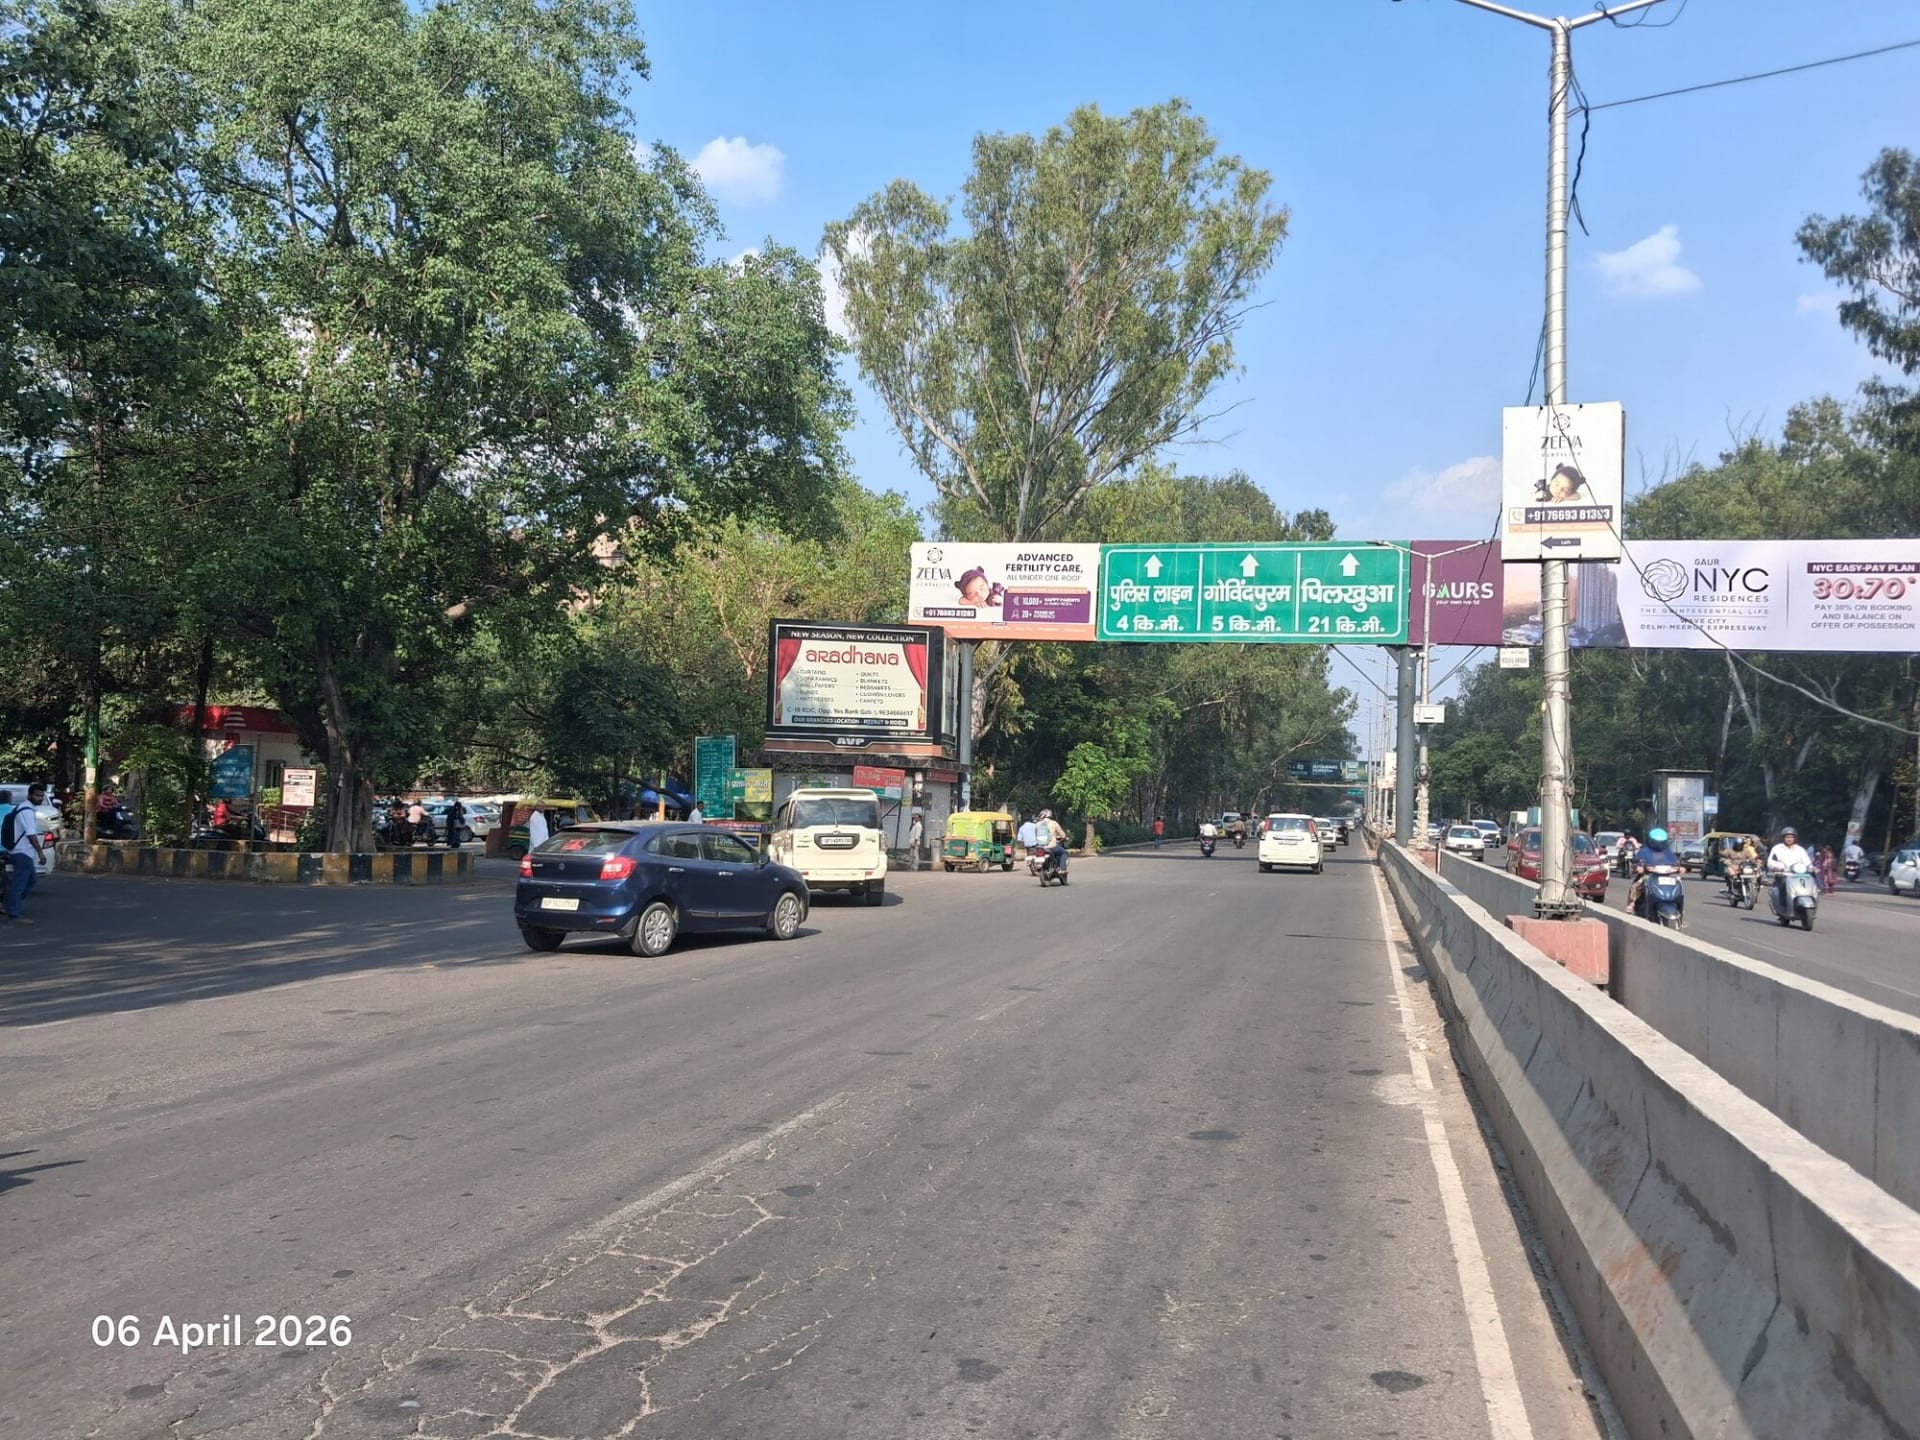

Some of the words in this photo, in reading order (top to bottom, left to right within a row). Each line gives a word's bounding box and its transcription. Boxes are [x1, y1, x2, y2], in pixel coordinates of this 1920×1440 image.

[1540, 435, 1583, 449] ZEEVA
[1016, 553, 1074, 562] ADVANCED
[1694, 558, 1720, 566] GAUR
[916, 567, 952, 580] ZEEVA
[1005, 563, 1052, 572] FERTILITY
[1053, 564, 1084, 573] CARE,
[1812, 564, 1834, 572] NYC
[1835, 564, 1886, 572] EASY-PAY
[1887, 564, 1915, 572] PLAN
[1694, 568, 1769, 593] NYC
[1110, 578, 1150, 611] पुलिस
[1153, 585, 1194, 605] लाइन
[1203, 578, 1292, 612] गोविंदपुरम
[1301, 578, 1395, 613] पिलखुआ
[1423, 581, 1494, 599] GAURS
[1694, 595, 1769, 603] RESIDENCES
[1116, 615, 1129, 631] 4
[1133, 615, 1184, 631] कि.मी.
[1212, 615, 1224, 631] 5
[1228, 615, 1282, 632] कि.मी.
[1308, 616, 1330, 633] 21
[1336, 616, 1385, 632] कि.मी.
[811, 631, 844, 640] SEASON,
[866, 633, 914, 642] COLLECTION
[836, 736, 865, 746] AVP
